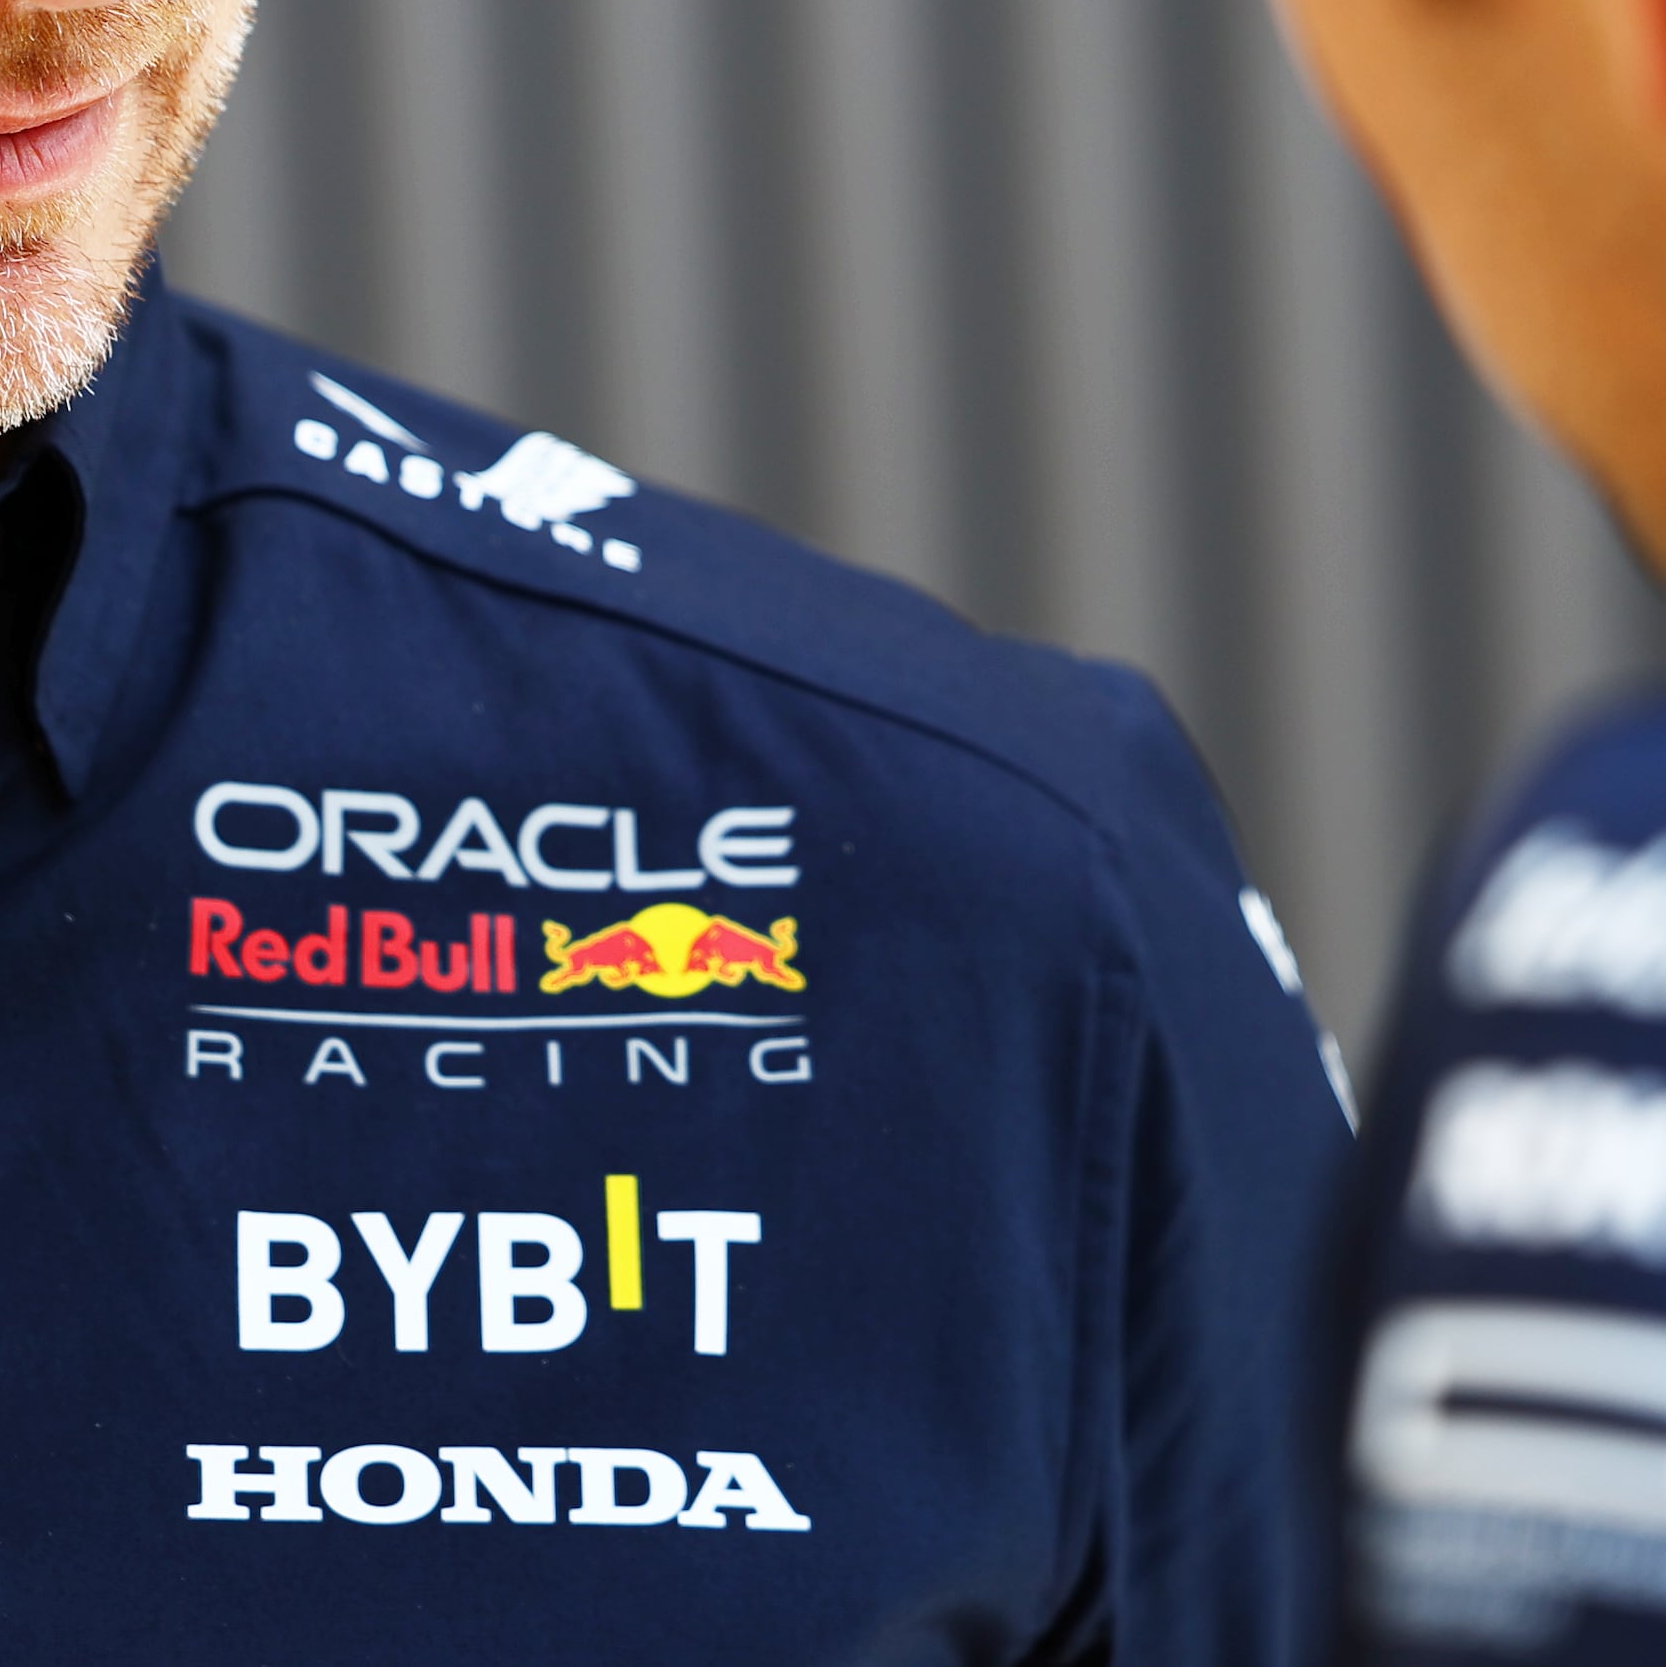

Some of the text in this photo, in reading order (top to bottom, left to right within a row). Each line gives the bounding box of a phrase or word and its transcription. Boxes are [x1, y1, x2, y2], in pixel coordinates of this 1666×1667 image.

[193, 780, 801, 891] ORACLE
[189, 897, 517, 994] Red Bull
[186, 1029, 813, 1088] RACING
[236, 1174, 762, 1357] BYBIT
[185, 1443, 812, 1531] HONDA
